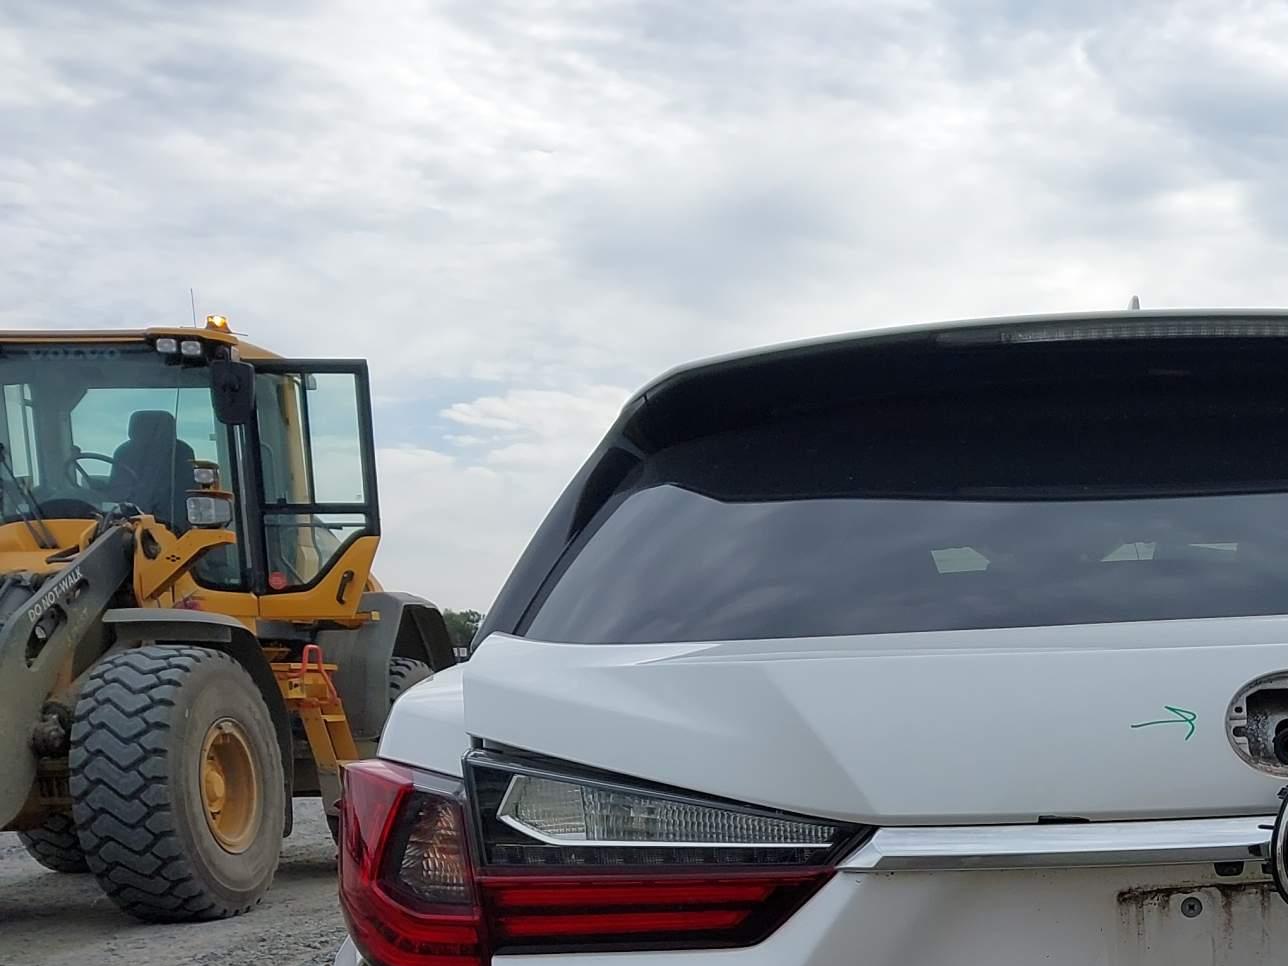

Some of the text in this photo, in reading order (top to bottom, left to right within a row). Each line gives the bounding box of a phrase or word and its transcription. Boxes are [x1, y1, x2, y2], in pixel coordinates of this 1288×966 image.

[28, 567, 83, 622] DO NOT WALK
